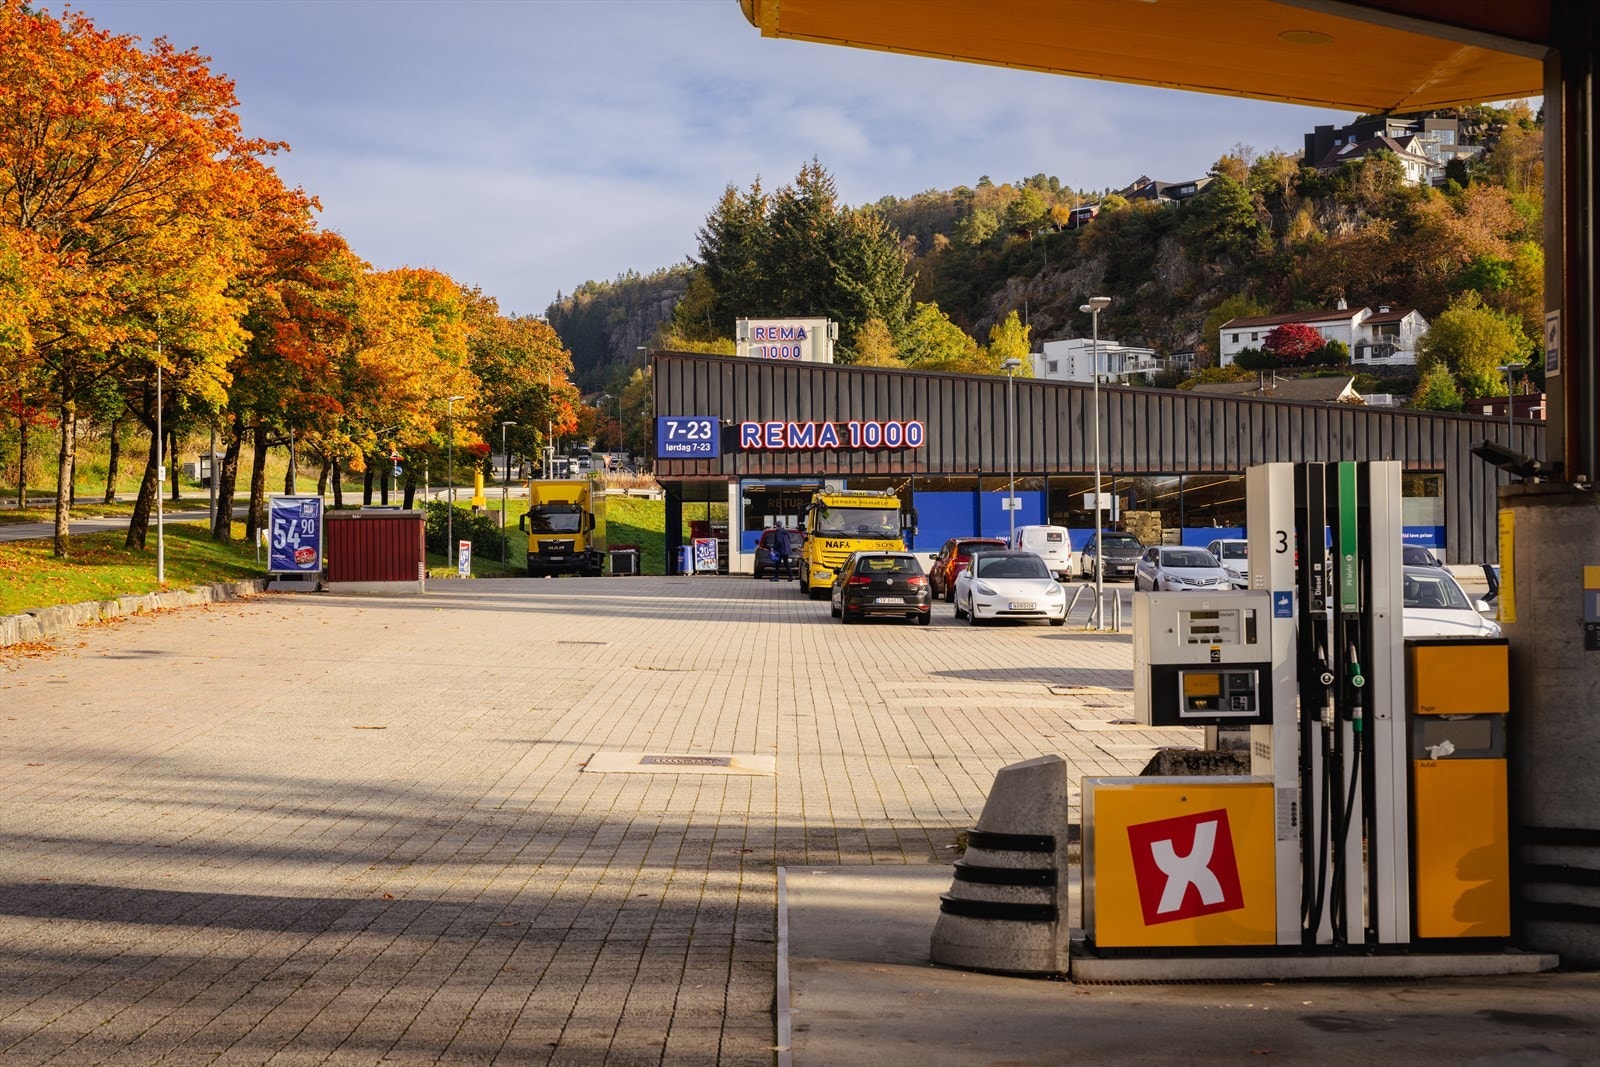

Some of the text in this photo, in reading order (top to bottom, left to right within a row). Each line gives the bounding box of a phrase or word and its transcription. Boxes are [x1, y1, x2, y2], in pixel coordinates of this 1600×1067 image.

[755, 326, 808, 341] REMA
[761, 345, 802, 359] 1000
[666, 421, 712, 439] 7-23
[740, 421, 923, 449] REMA 1000
[665, 443, 711, 452] lørdag 7-23
[273, 518, 315, 549] 54 90
[1275, 530, 1288, 554] 3
[825, 540, 844, 548] NAF
[1314, 575, 1323, 596] Diesel
